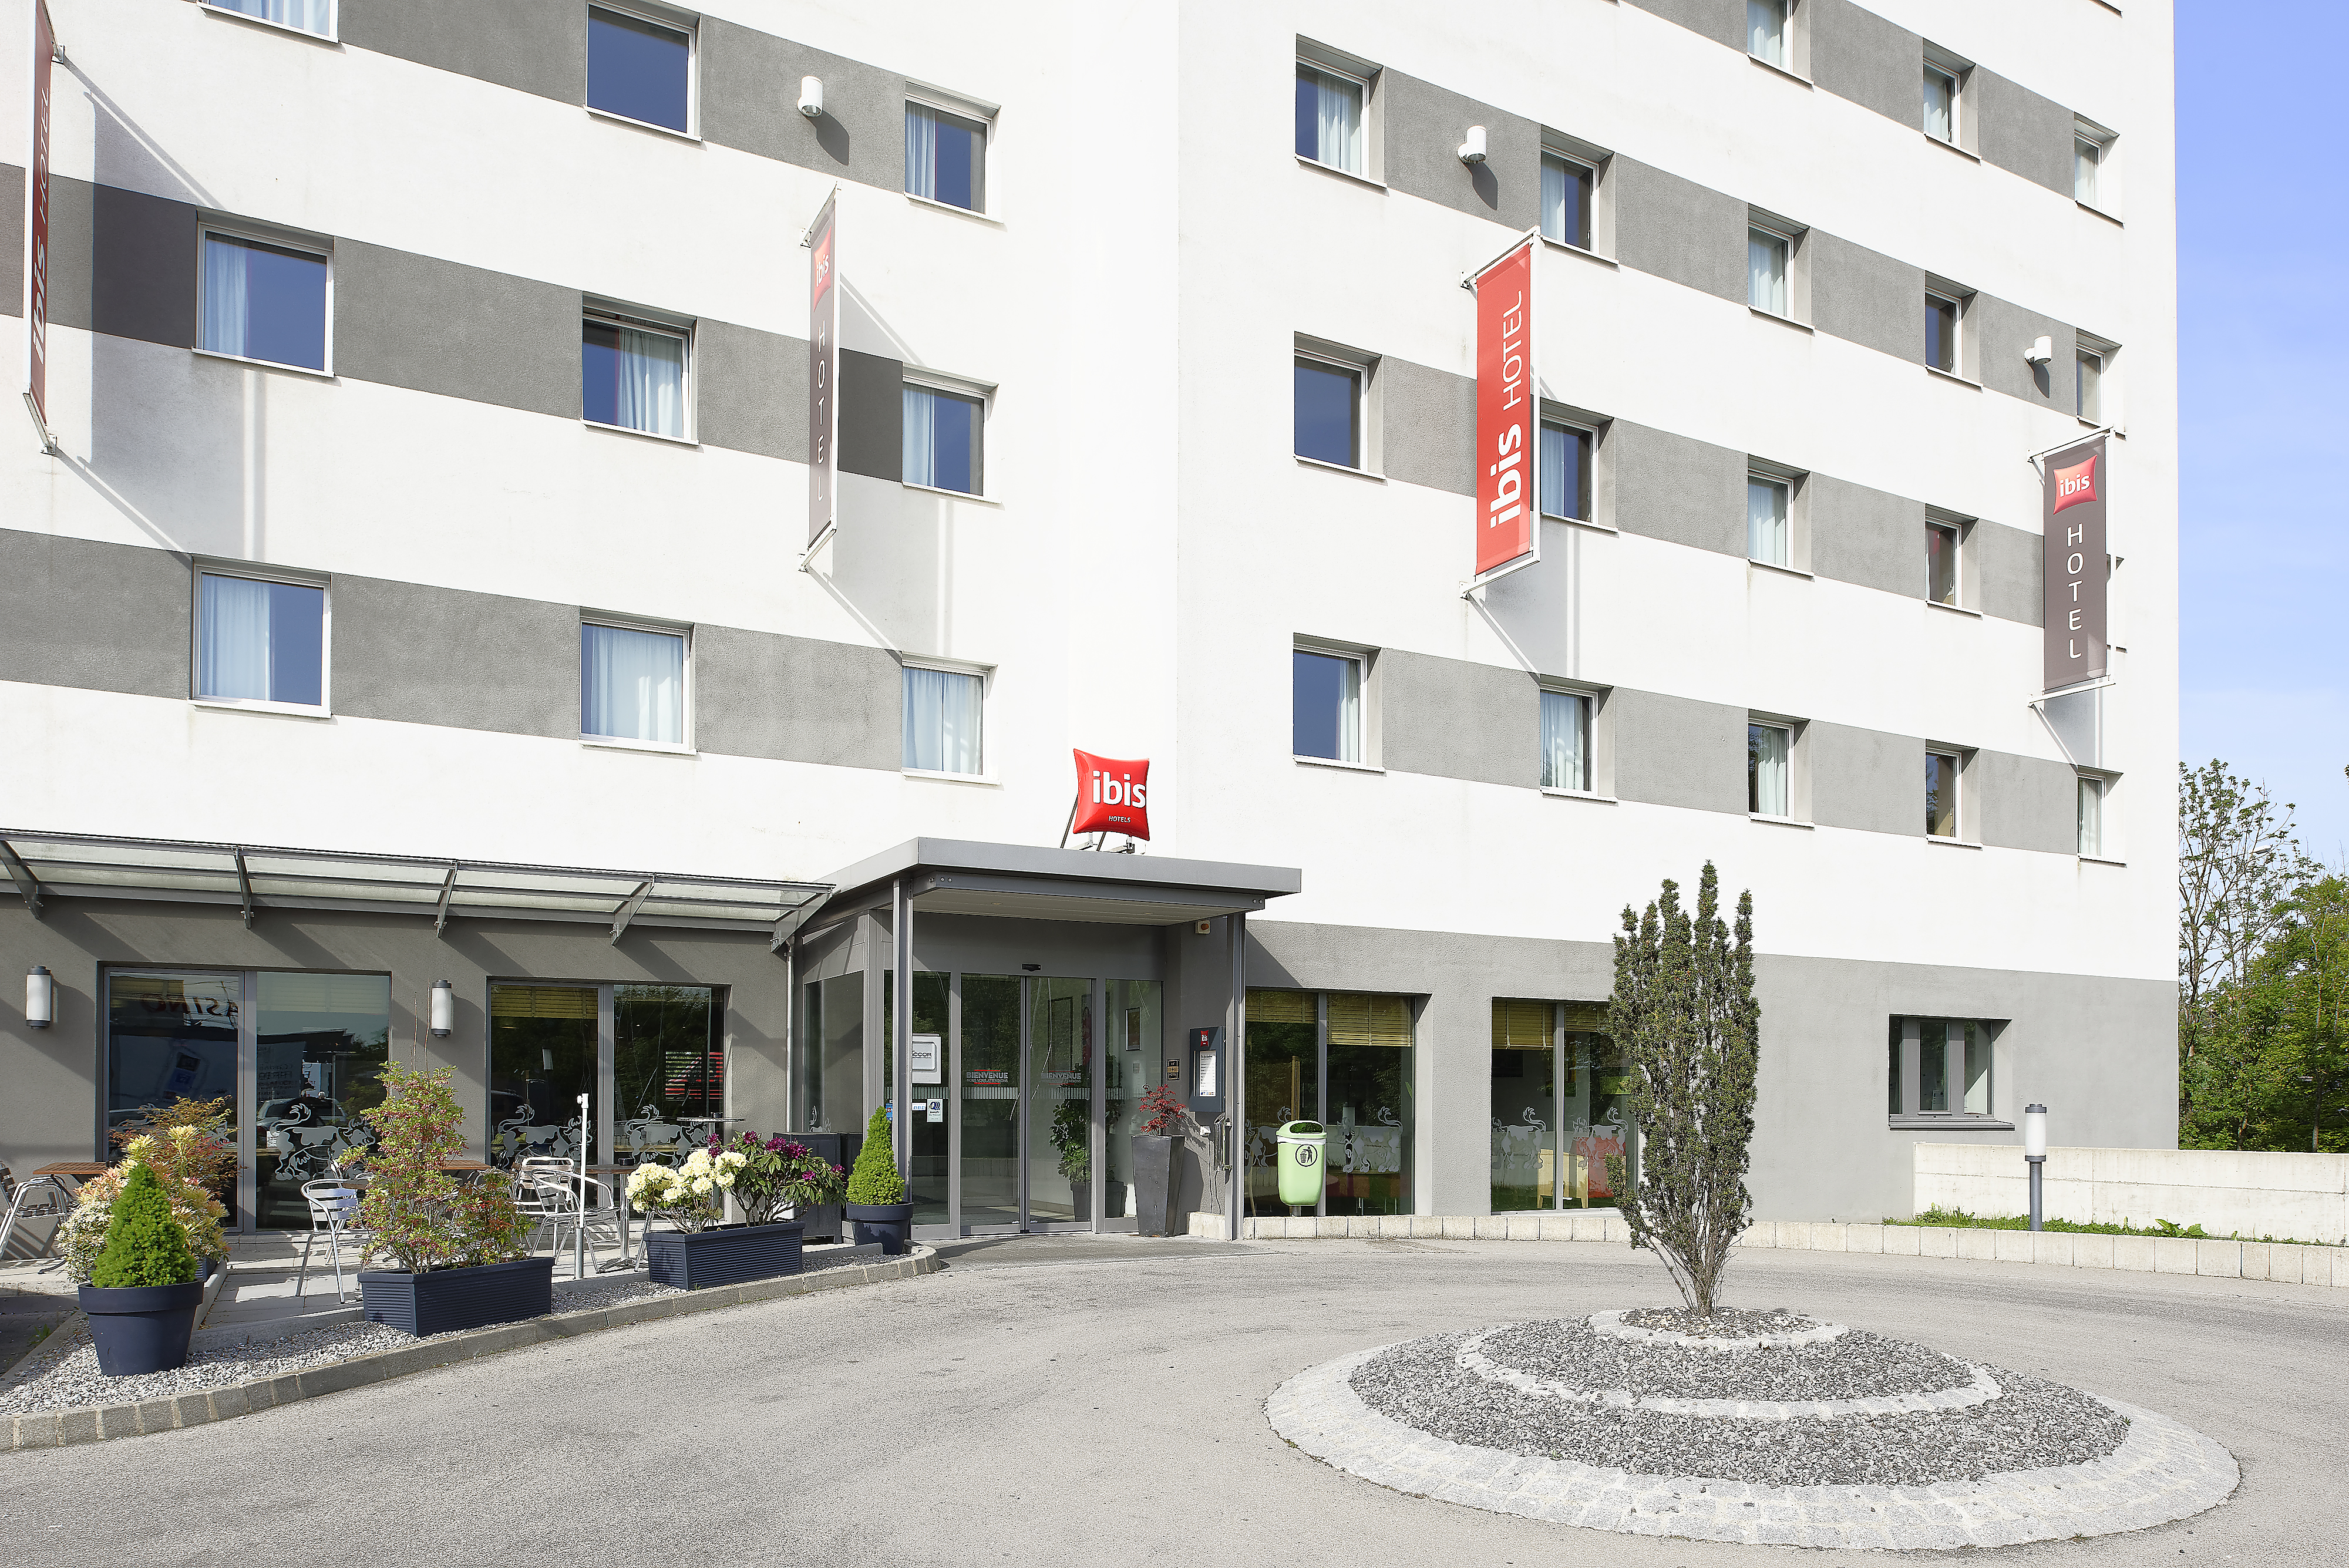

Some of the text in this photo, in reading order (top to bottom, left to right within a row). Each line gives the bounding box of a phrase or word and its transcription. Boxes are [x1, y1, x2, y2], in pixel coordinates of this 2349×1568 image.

[33, 87, 49, 365] ibis HOTEL
[816, 253, 830, 288] ibis
[1490, 290, 1523, 529] ibis HOTEL
[2059, 473, 2091, 497] ibis
[2067, 523, 2084, 659] HOTEL
[1092, 770, 1146, 809] ibis
